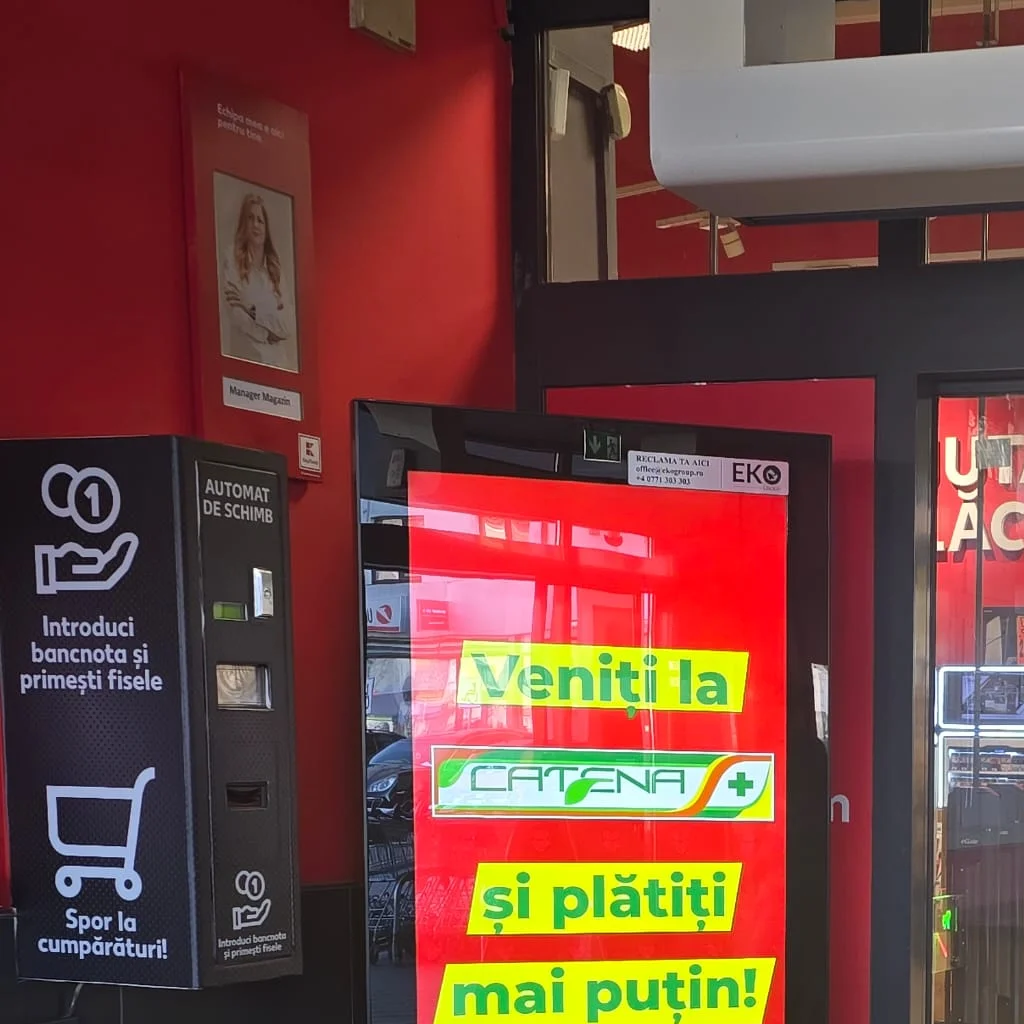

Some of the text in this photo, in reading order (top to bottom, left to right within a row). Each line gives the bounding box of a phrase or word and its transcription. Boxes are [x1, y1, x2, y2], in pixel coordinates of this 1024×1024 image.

[229, 385, 291, 406] Manager Magazin
[636, 455, 677, 465] RECLAMA
[680, 458, 689, 466] TA
[733, 462, 781, 485] EKO
[205, 478, 270, 503] AUTOMAT
[203, 499, 273, 524] DE SCHIMB
[43, 615, 135, 637] Introduci
[31, 642, 149, 669] bancnota și
[20, 669, 163, 695] primești fisele
[470, 652, 728, 719] Veniți la
[471, 765, 685, 806] CATENA
[482, 872, 725, 934] și plătiți
[65, 908, 136, 934] Spor la
[38, 936, 168, 959] cumpărături!
[218, 931, 287, 948] Introduci bancnota
[263, 942, 282, 953] fisele
[453, 964, 757, 1024] mai puțin!
